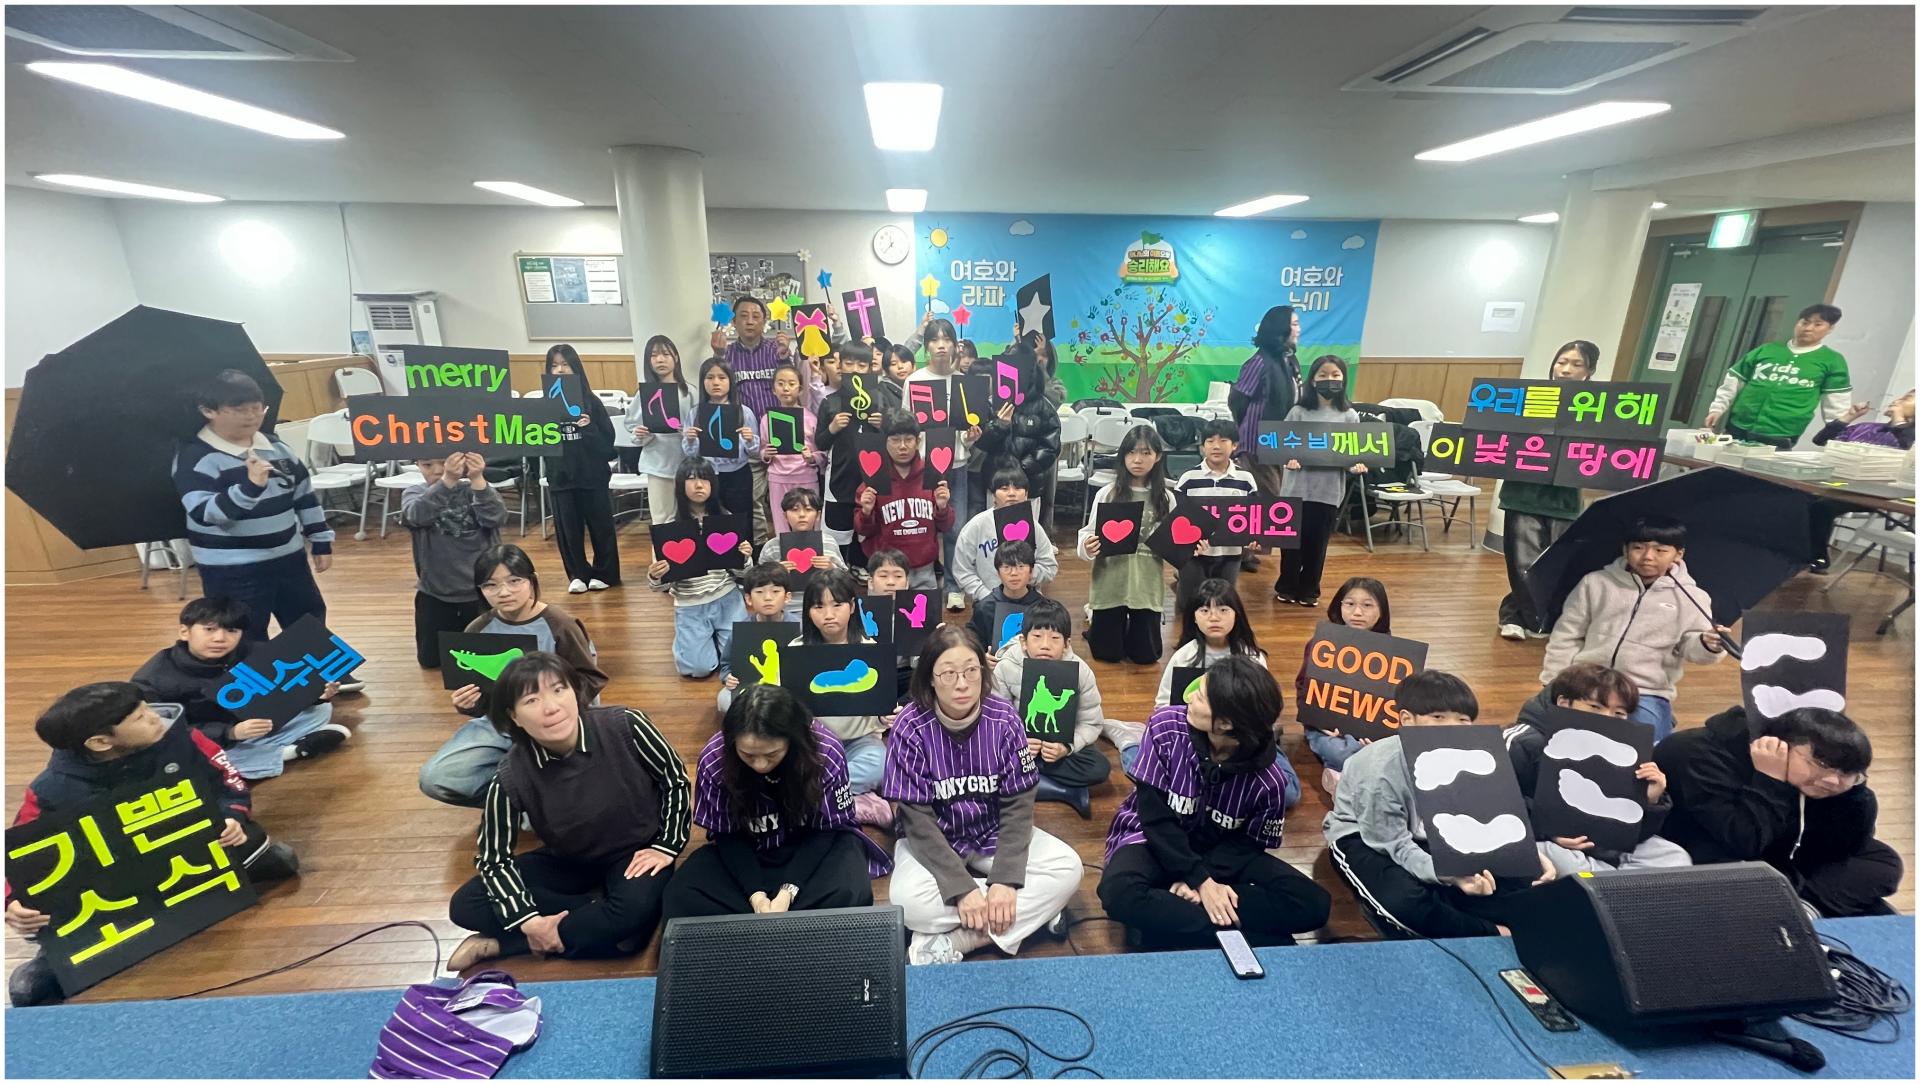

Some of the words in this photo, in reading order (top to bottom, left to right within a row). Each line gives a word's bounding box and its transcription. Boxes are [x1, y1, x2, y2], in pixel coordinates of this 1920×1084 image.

[951, 259, 1017, 282] 여호와
[1281, 266, 1344, 287] 여호와
[962, 285, 1006, 307] 라파
[405, 362, 508, 393] merry
[1467, 383, 1561, 418] 우리를
[1258, 431, 1389, 456] 예수님께서
[1431, 436, 1464, 465] 이
[1474, 434, 1552, 472] 낮은
[1567, 442, 1657, 480] 땅에
[881, 498, 905, 524] NEW
[216, 634, 365, 710] 예수님
[1311, 639, 1414, 685] GOOD
[1305, 678, 1400, 729] NEWS
[932, 774, 999, 800] NNYGRE
[8, 778, 213, 896] 기쁜
[56, 839, 241, 966] 소식
